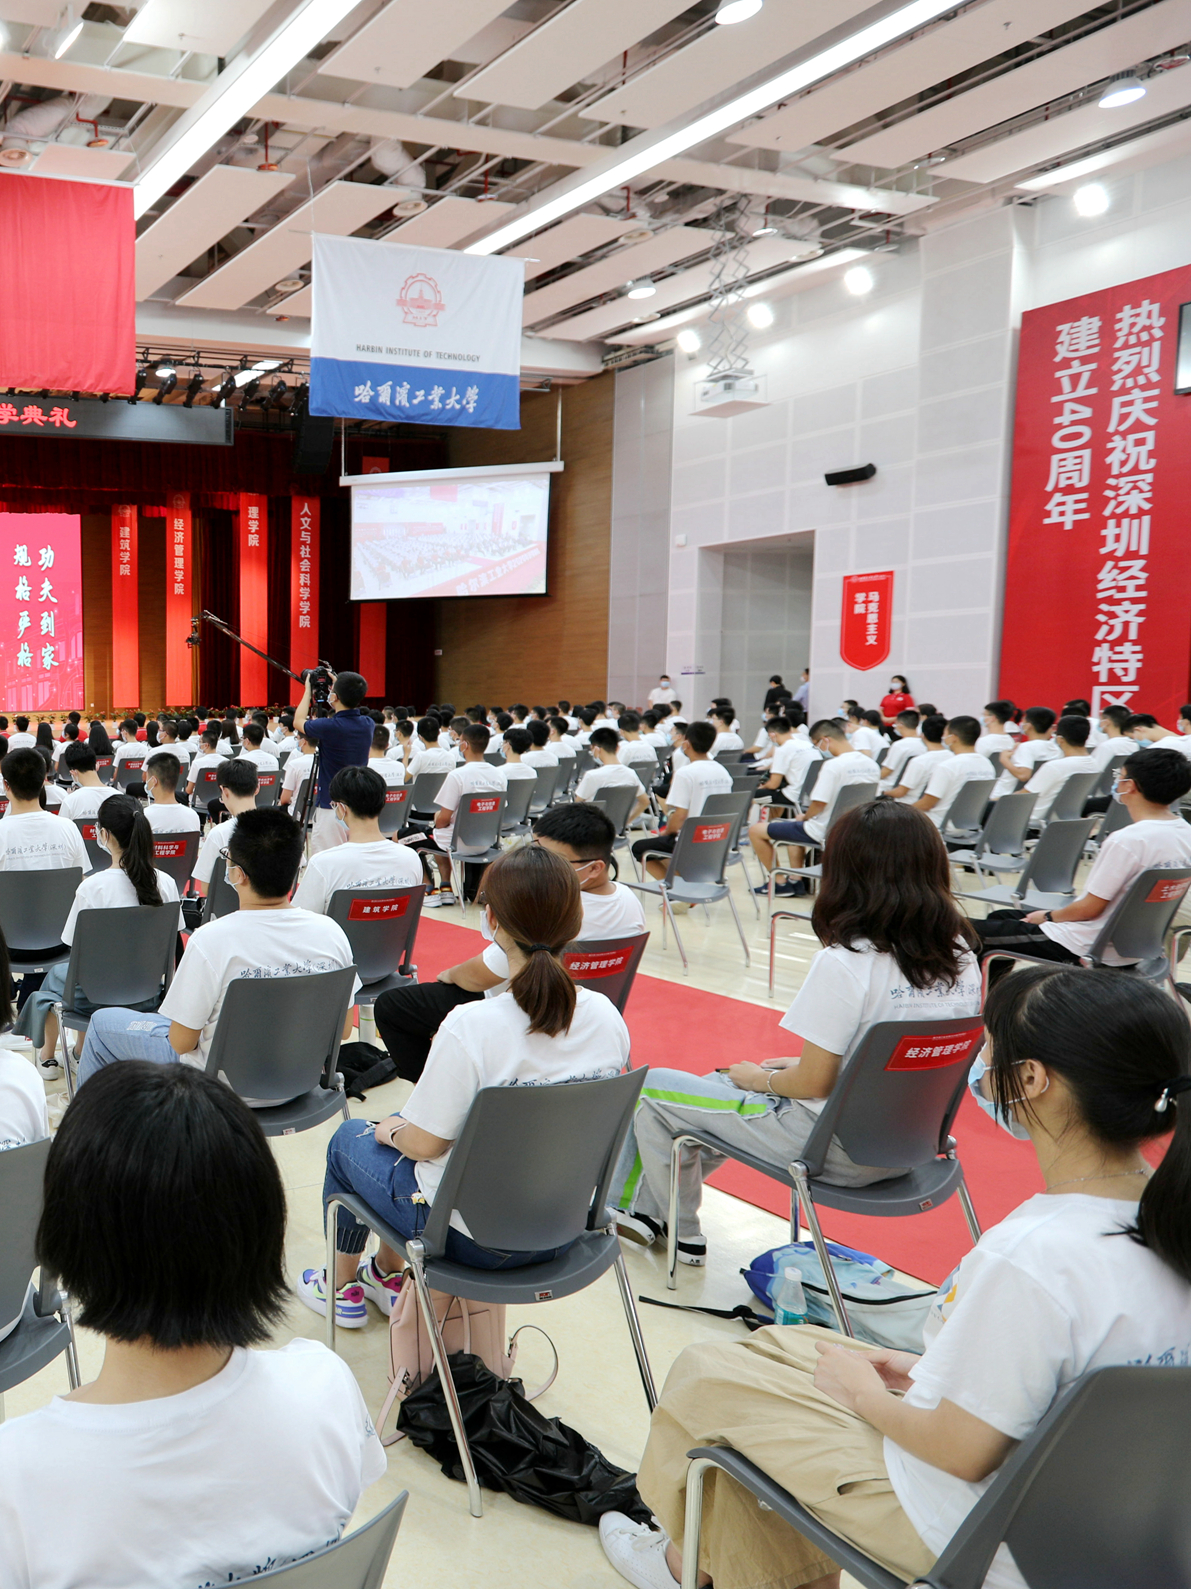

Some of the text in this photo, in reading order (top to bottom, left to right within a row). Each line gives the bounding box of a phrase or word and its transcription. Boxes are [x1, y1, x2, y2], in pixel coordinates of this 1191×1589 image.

[356, 343, 481, 363] HARBIN INSTITUTE OF TECHNOLOGY
[1042, 315, 1103, 530] 建立40周年
[247, 505, 259, 547] 理学院
[1091, 299, 1166, 715] 热烈庆祝深圳经济特区
[119, 526, 131, 576] 建筑学院
[173, 518, 185, 595] 经济管理学院
[299, 502, 312, 628] 人文与社会科学学院
[13, 543, 34, 667] 规格严格
[37, 544, 59, 671] 功夫到家
[853, 592, 867, 614] 学院
[865, 591, 879, 646] 马克思主义
[362, 904, 400, 914] 建筑学院
[569, 956, 624, 971] 经济管理学院
[904, 1039, 973, 1059] 经济管理学院
